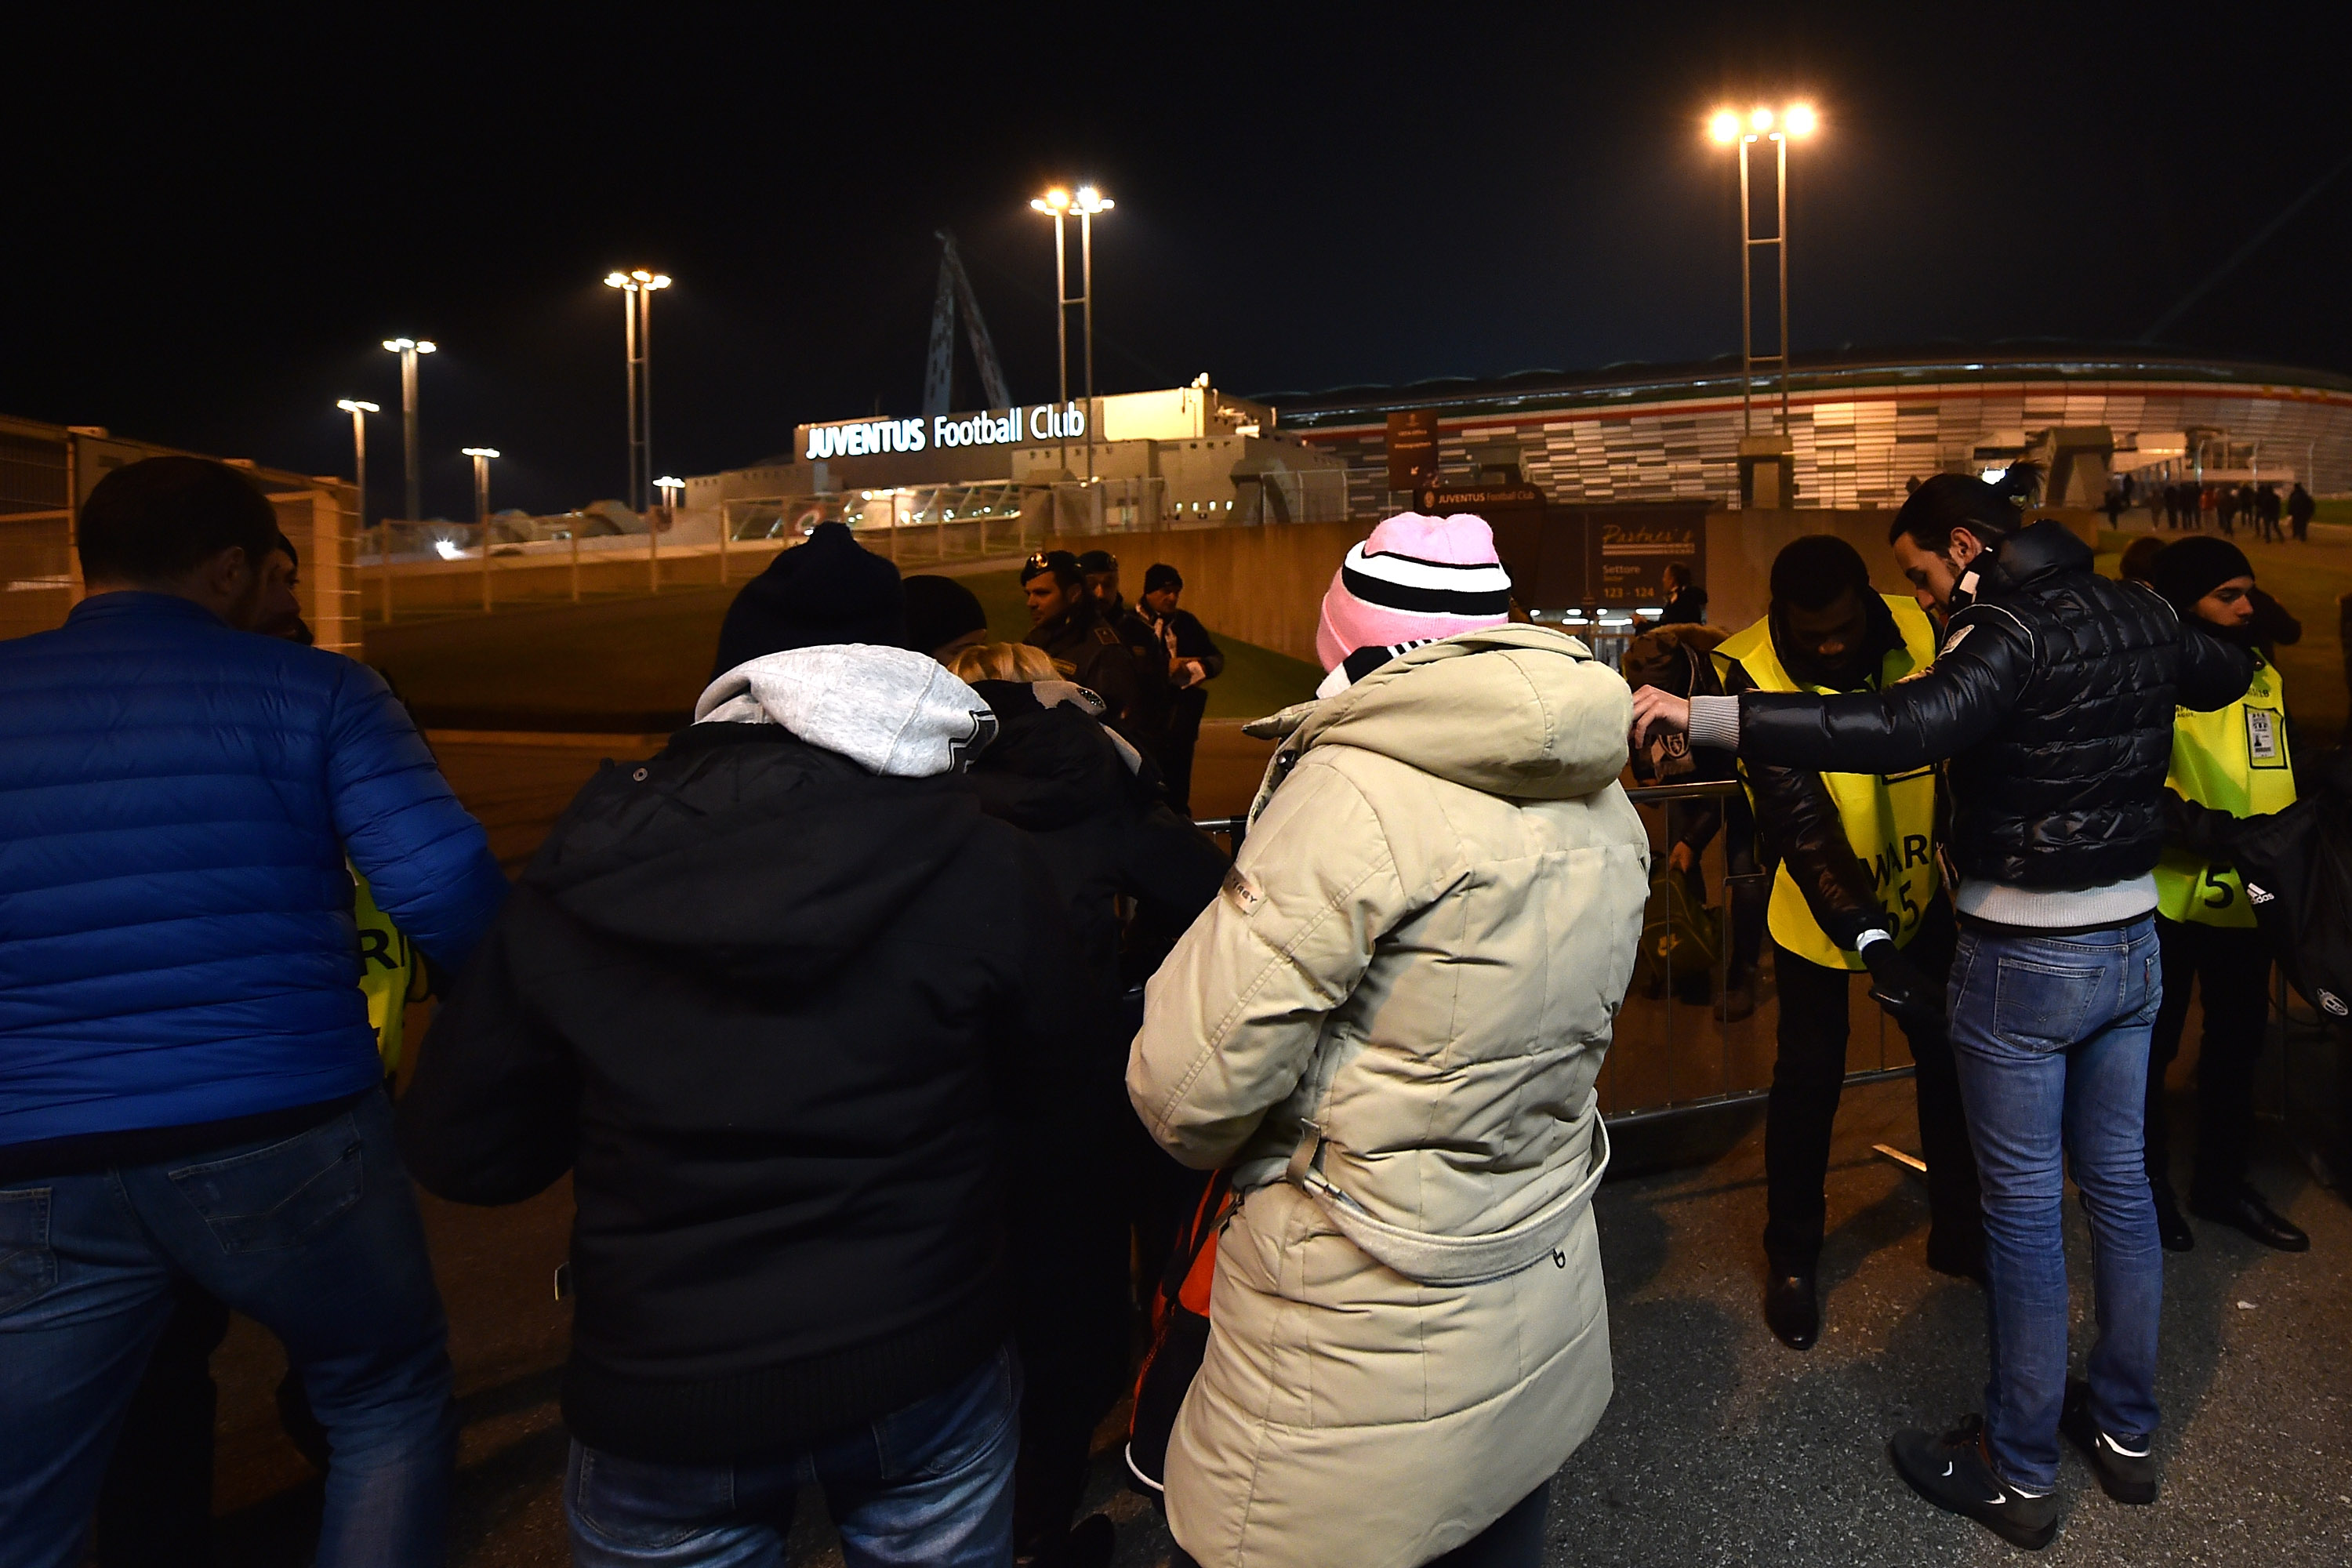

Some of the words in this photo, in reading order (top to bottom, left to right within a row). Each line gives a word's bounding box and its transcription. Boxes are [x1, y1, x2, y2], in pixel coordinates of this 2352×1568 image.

[806, 418, 926, 459] JUVENTUS
[934, 407, 1022, 448] Football
[1030, 401, 1085, 439] Club
[1439, 492, 1485, 504] JUVENTUS
[1486, 491, 1516, 502] Football
[1517, 490, 1535, 500] Club
[1602, 564, 1641, 575] Settore
[1604, 587, 1624, 598] 123
